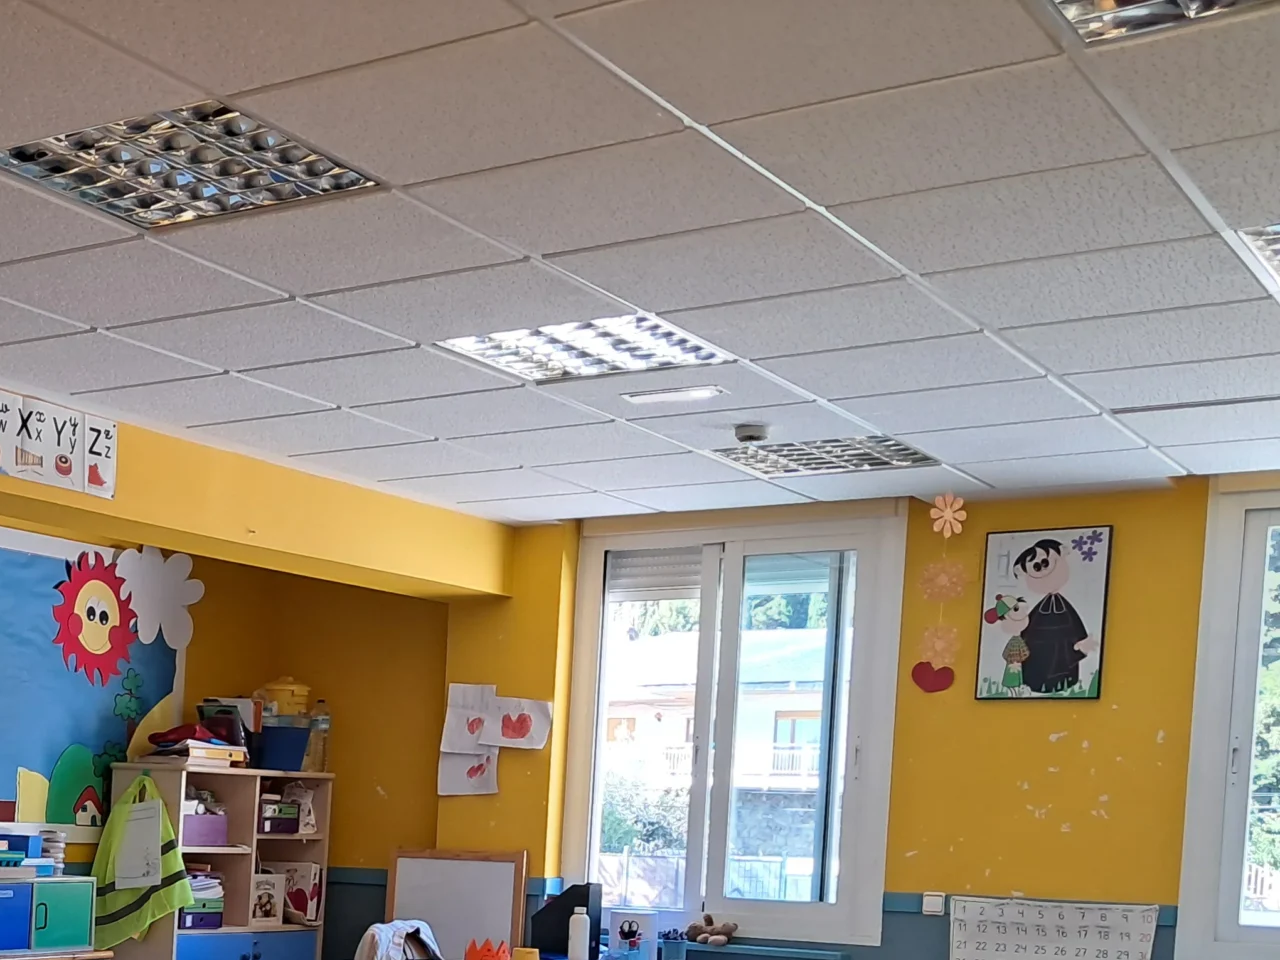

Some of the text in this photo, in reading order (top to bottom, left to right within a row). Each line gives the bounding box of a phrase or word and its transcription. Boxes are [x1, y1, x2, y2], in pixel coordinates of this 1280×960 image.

[17, 409, 33, 439] X
[53, 417, 67, 446] Y
[89, 427, 102, 456] Z
[958, 922, 967, 932] 11
[976, 923, 988, 933] 12
[996, 925, 1007, 935] 13
[1016, 926, 1028, 936] 14
[1036, 927, 1047, 937] 15
[1056, 928, 1068, 938] 16
[1077, 929, 1088, 939] 17
[1098, 930, 1110, 940] 18
[1120, 931, 1131, 941] 19
[956, 940, 1130, 960] 21 22 23 24 25 26 27 28 29
